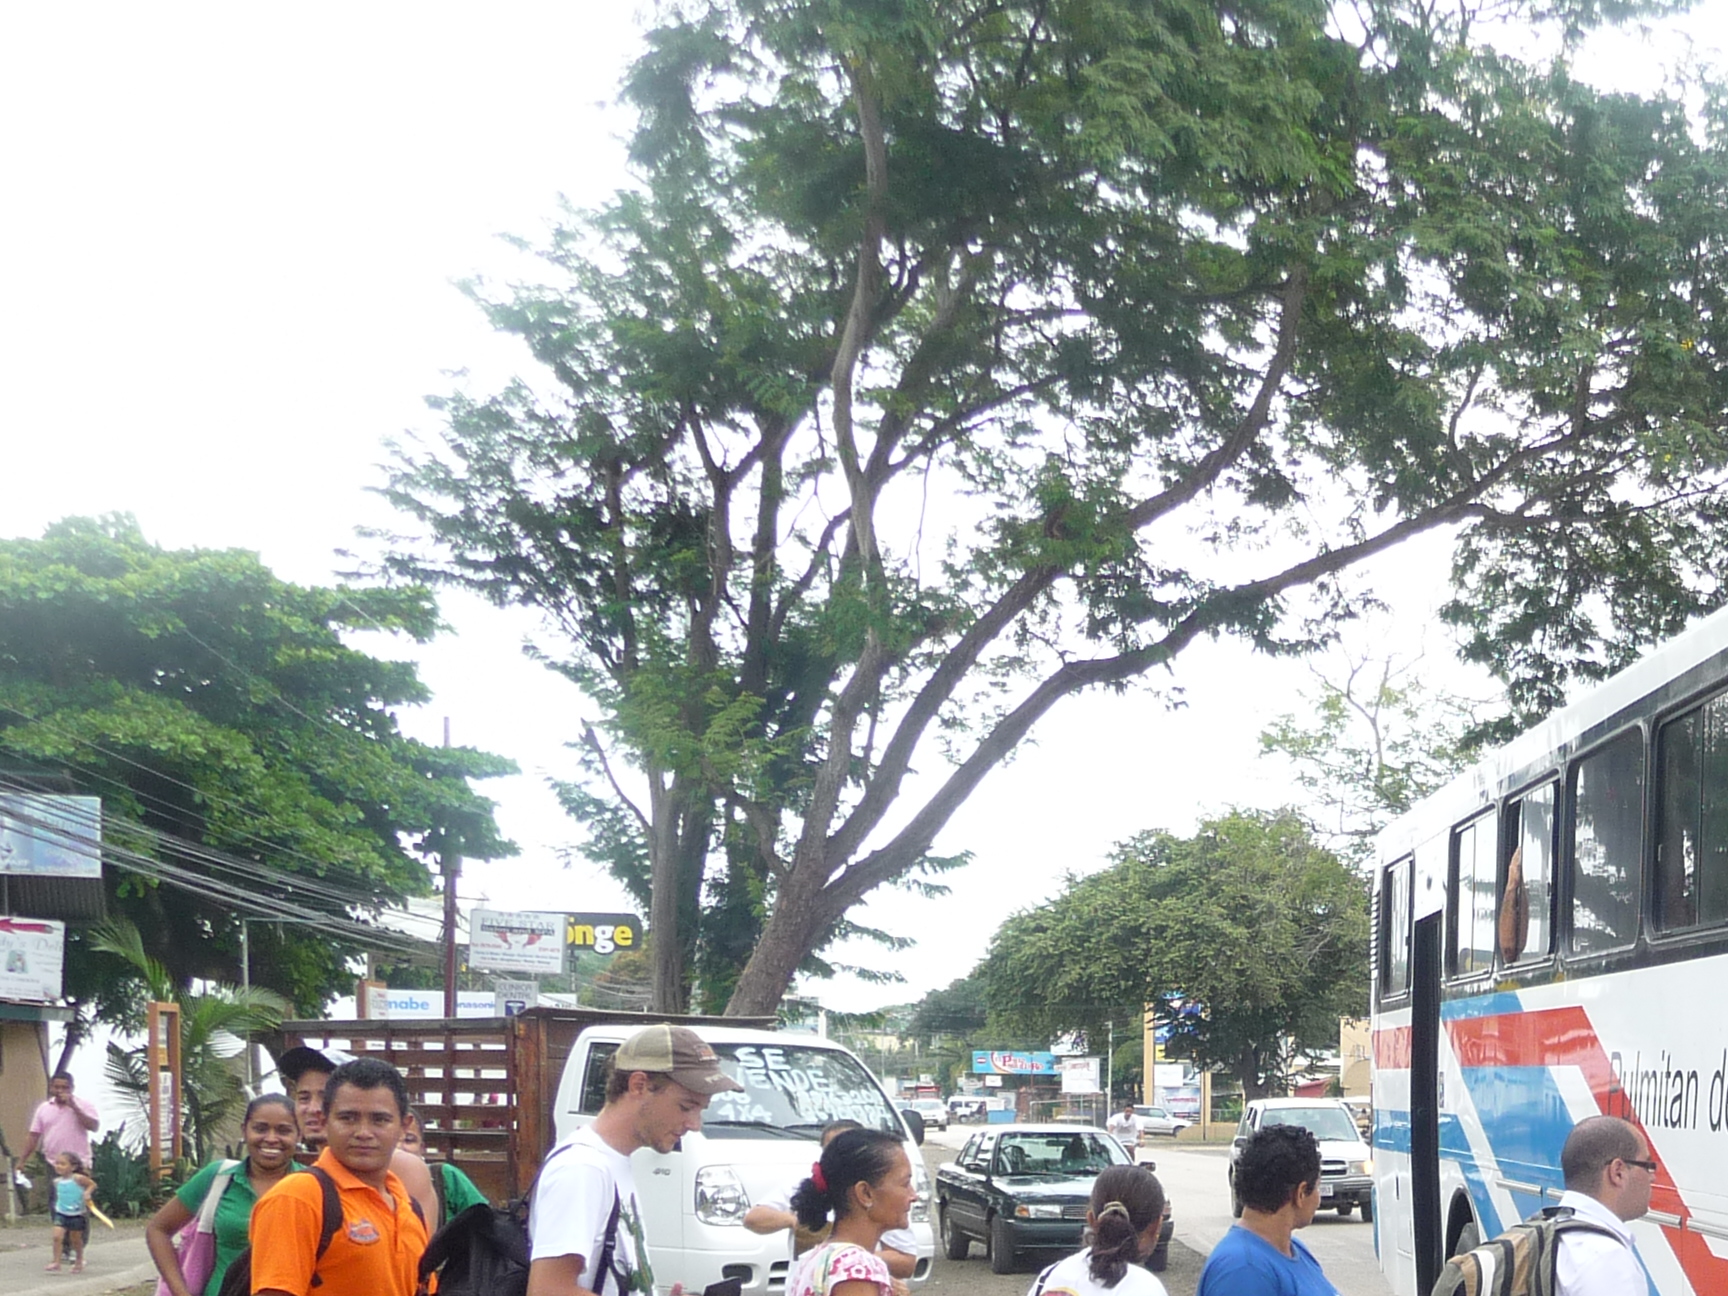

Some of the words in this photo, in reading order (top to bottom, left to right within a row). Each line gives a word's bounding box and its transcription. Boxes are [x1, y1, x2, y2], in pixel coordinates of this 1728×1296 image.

[518, 919, 555, 930] STAR
[735, 1047, 791, 1070] SE
[1608, 1049, 1698, 1131] Pulmitan
